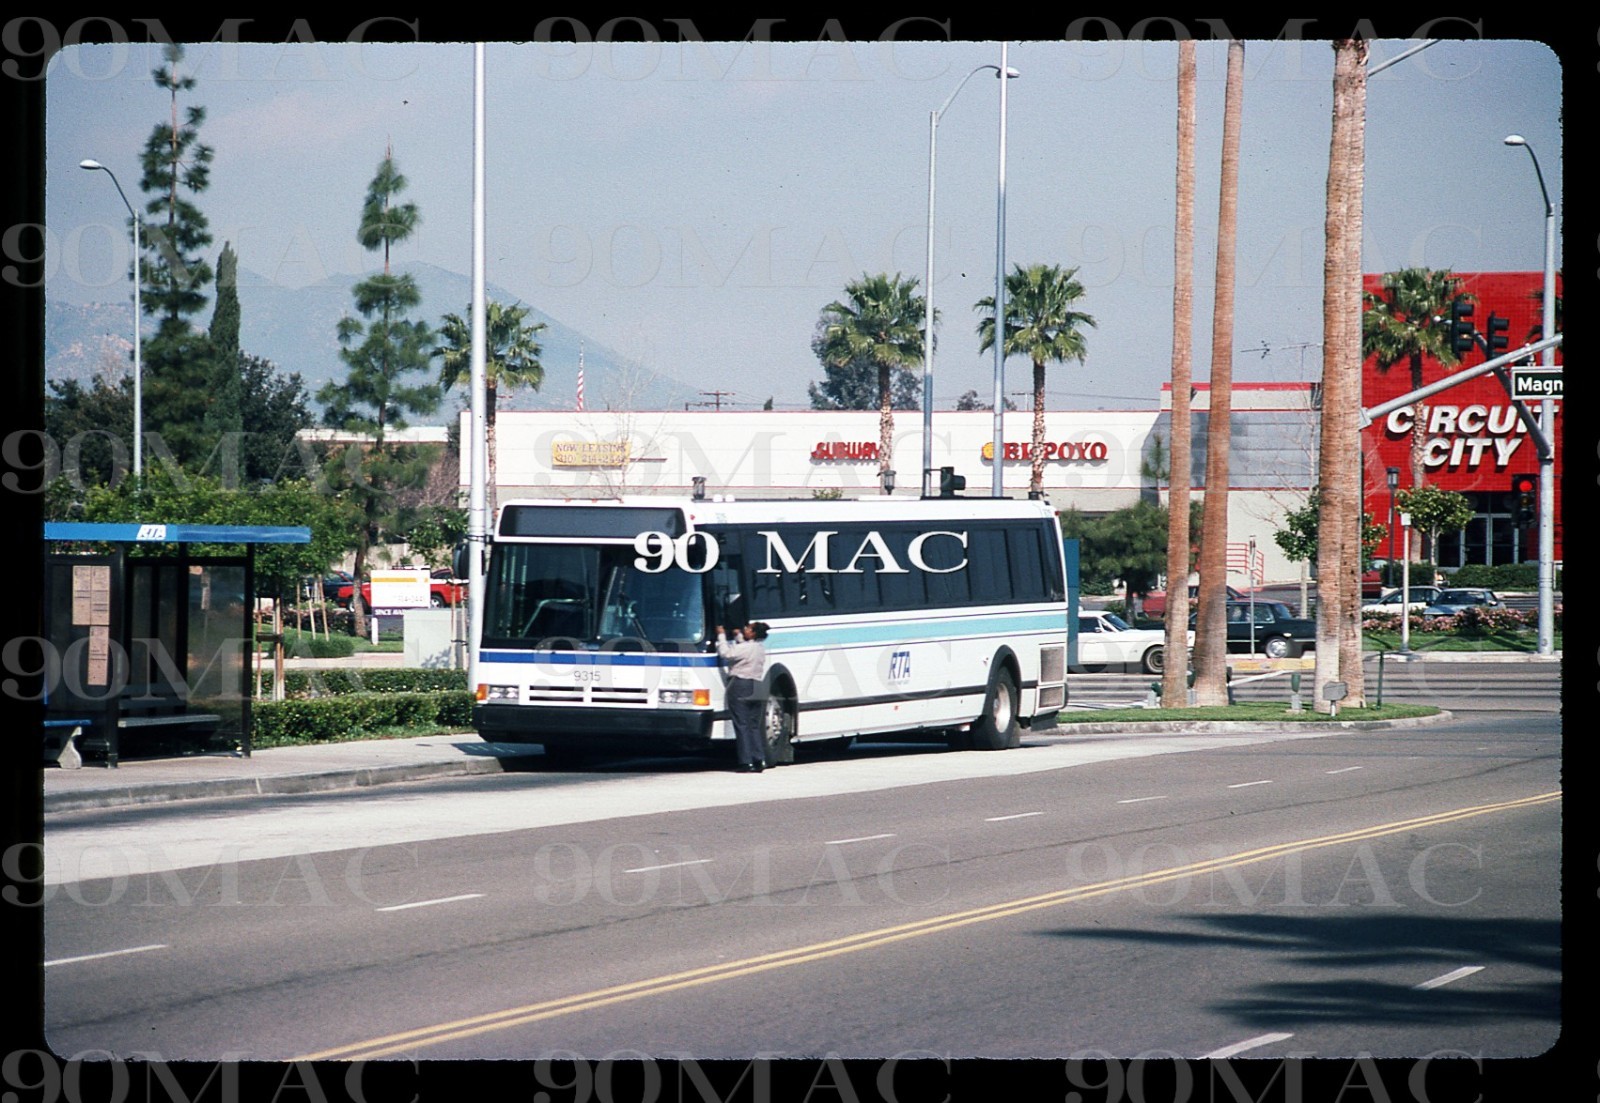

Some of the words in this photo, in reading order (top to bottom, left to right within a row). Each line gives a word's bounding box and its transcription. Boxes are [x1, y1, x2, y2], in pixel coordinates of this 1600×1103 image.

[1517, 377, 1563, 395] Magn
[1423, 438, 1522, 466] CITY
[136, 524, 166, 540] RTA
[888, 650, 911, 679] RTA
[573, 670, 601, 682] 9315
